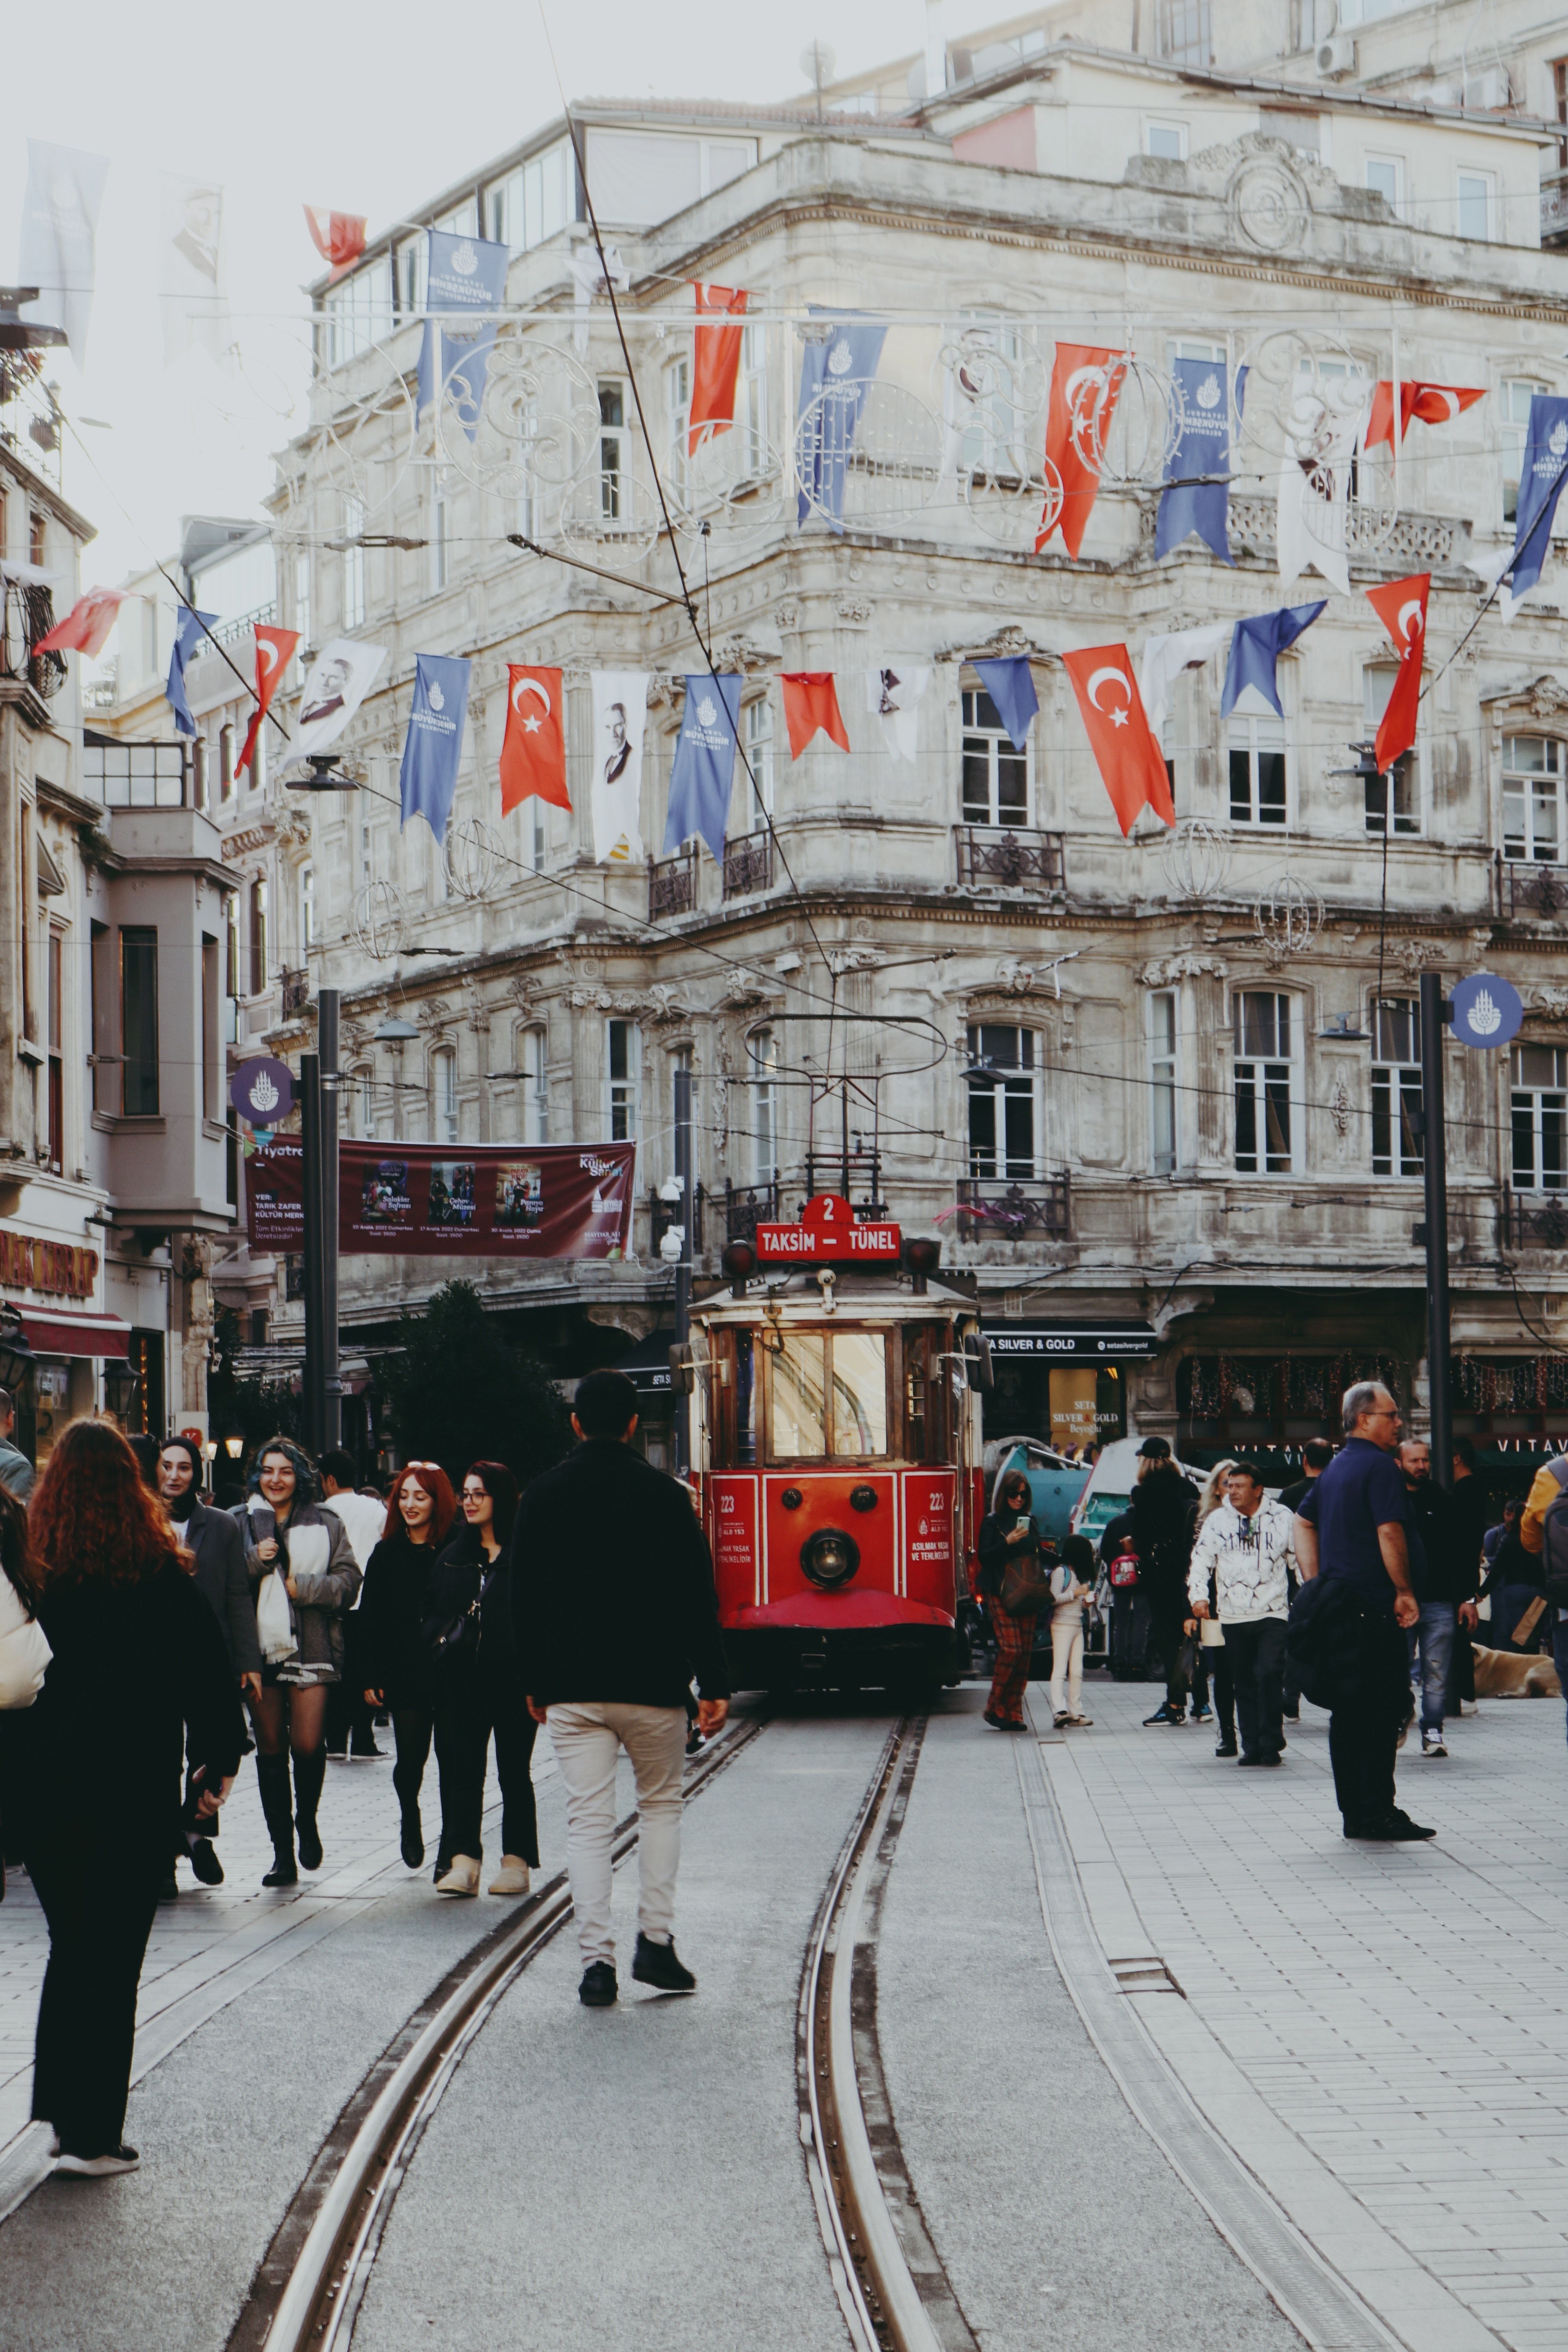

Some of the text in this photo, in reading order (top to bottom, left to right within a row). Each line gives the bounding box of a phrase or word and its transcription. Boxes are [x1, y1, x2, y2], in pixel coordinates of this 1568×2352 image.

[256, 1210, 283, 1218] KÜLTÜR
[823, 1198, 834, 1221] 2
[763, 1228, 815, 1251] TAKSİM
[849, 1227, 896, 1250] TÜNEL
[998, 1339, 1034, 1350] SILVER
[1036, 1339, 1044, 1350] &
[1046, 1339, 1075, 1350] GOLD
[1106, 1342, 1149, 1351] setasilvergold
[652, 1374, 665, 1385] SETA
[1074, 1401, 1096, 1410] SETA
[1053, 1413, 1083, 1423] SILVER
[1093, 1413, 1118, 1423] GOLD
[721, 1495, 734, 1513] 223
[929, 1492, 944, 1511] 223
[912, 1542, 937, 1551] ASILMAK
[912, 1552, 920, 1561] VE
